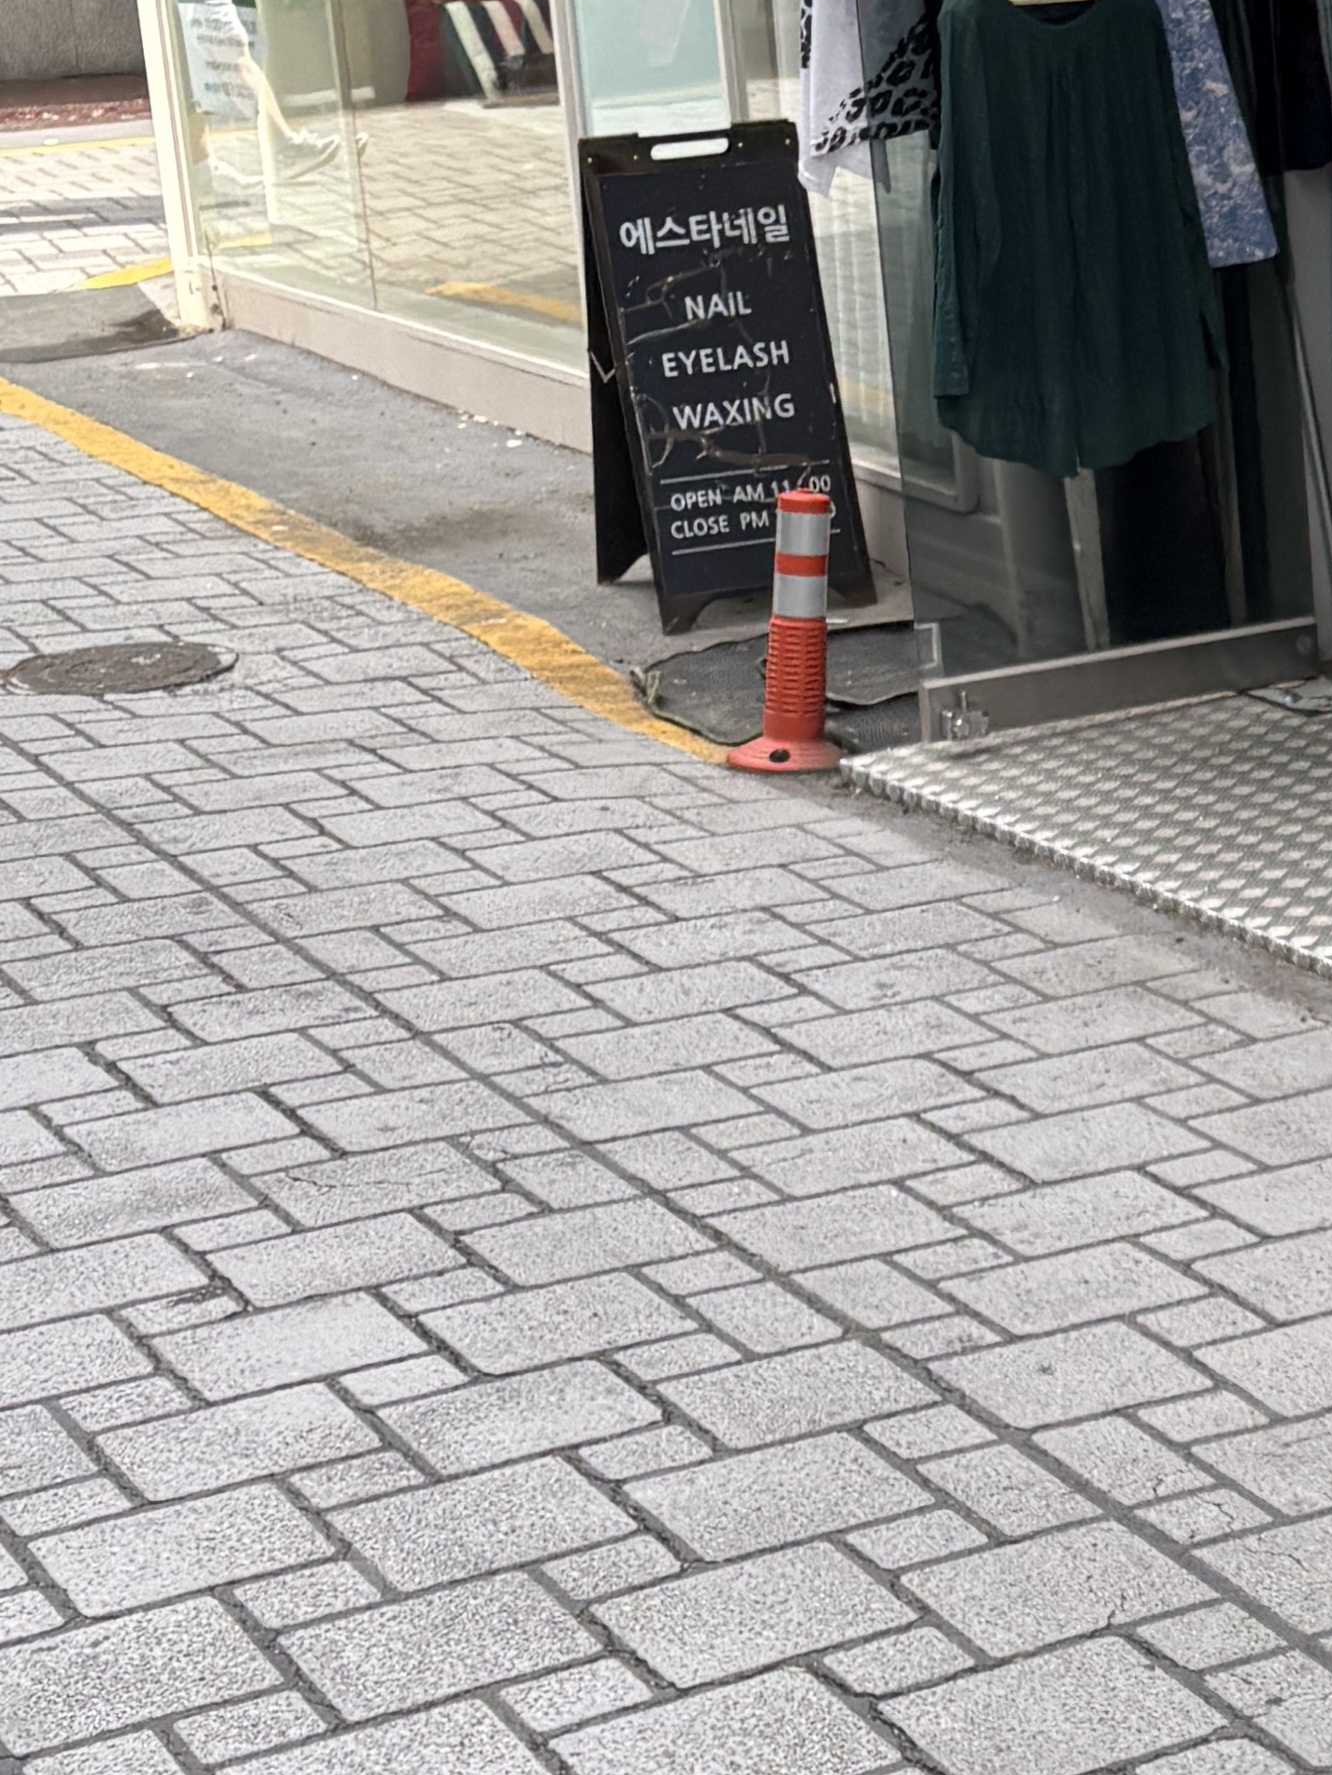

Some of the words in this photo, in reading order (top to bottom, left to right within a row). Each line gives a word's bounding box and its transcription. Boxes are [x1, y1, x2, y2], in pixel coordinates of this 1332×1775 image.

[619, 204, 791, 256] 에스타네일
[684, 291, 752, 321] NAIL
[661, 340, 790, 379] EYELASH
[672, 393, 796, 430] WAXING
[670, 487, 722, 512] OPEN
[733, 482, 765, 504] AM
[670, 514, 730, 540] CLOSE
[739, 510, 770, 531] PM
